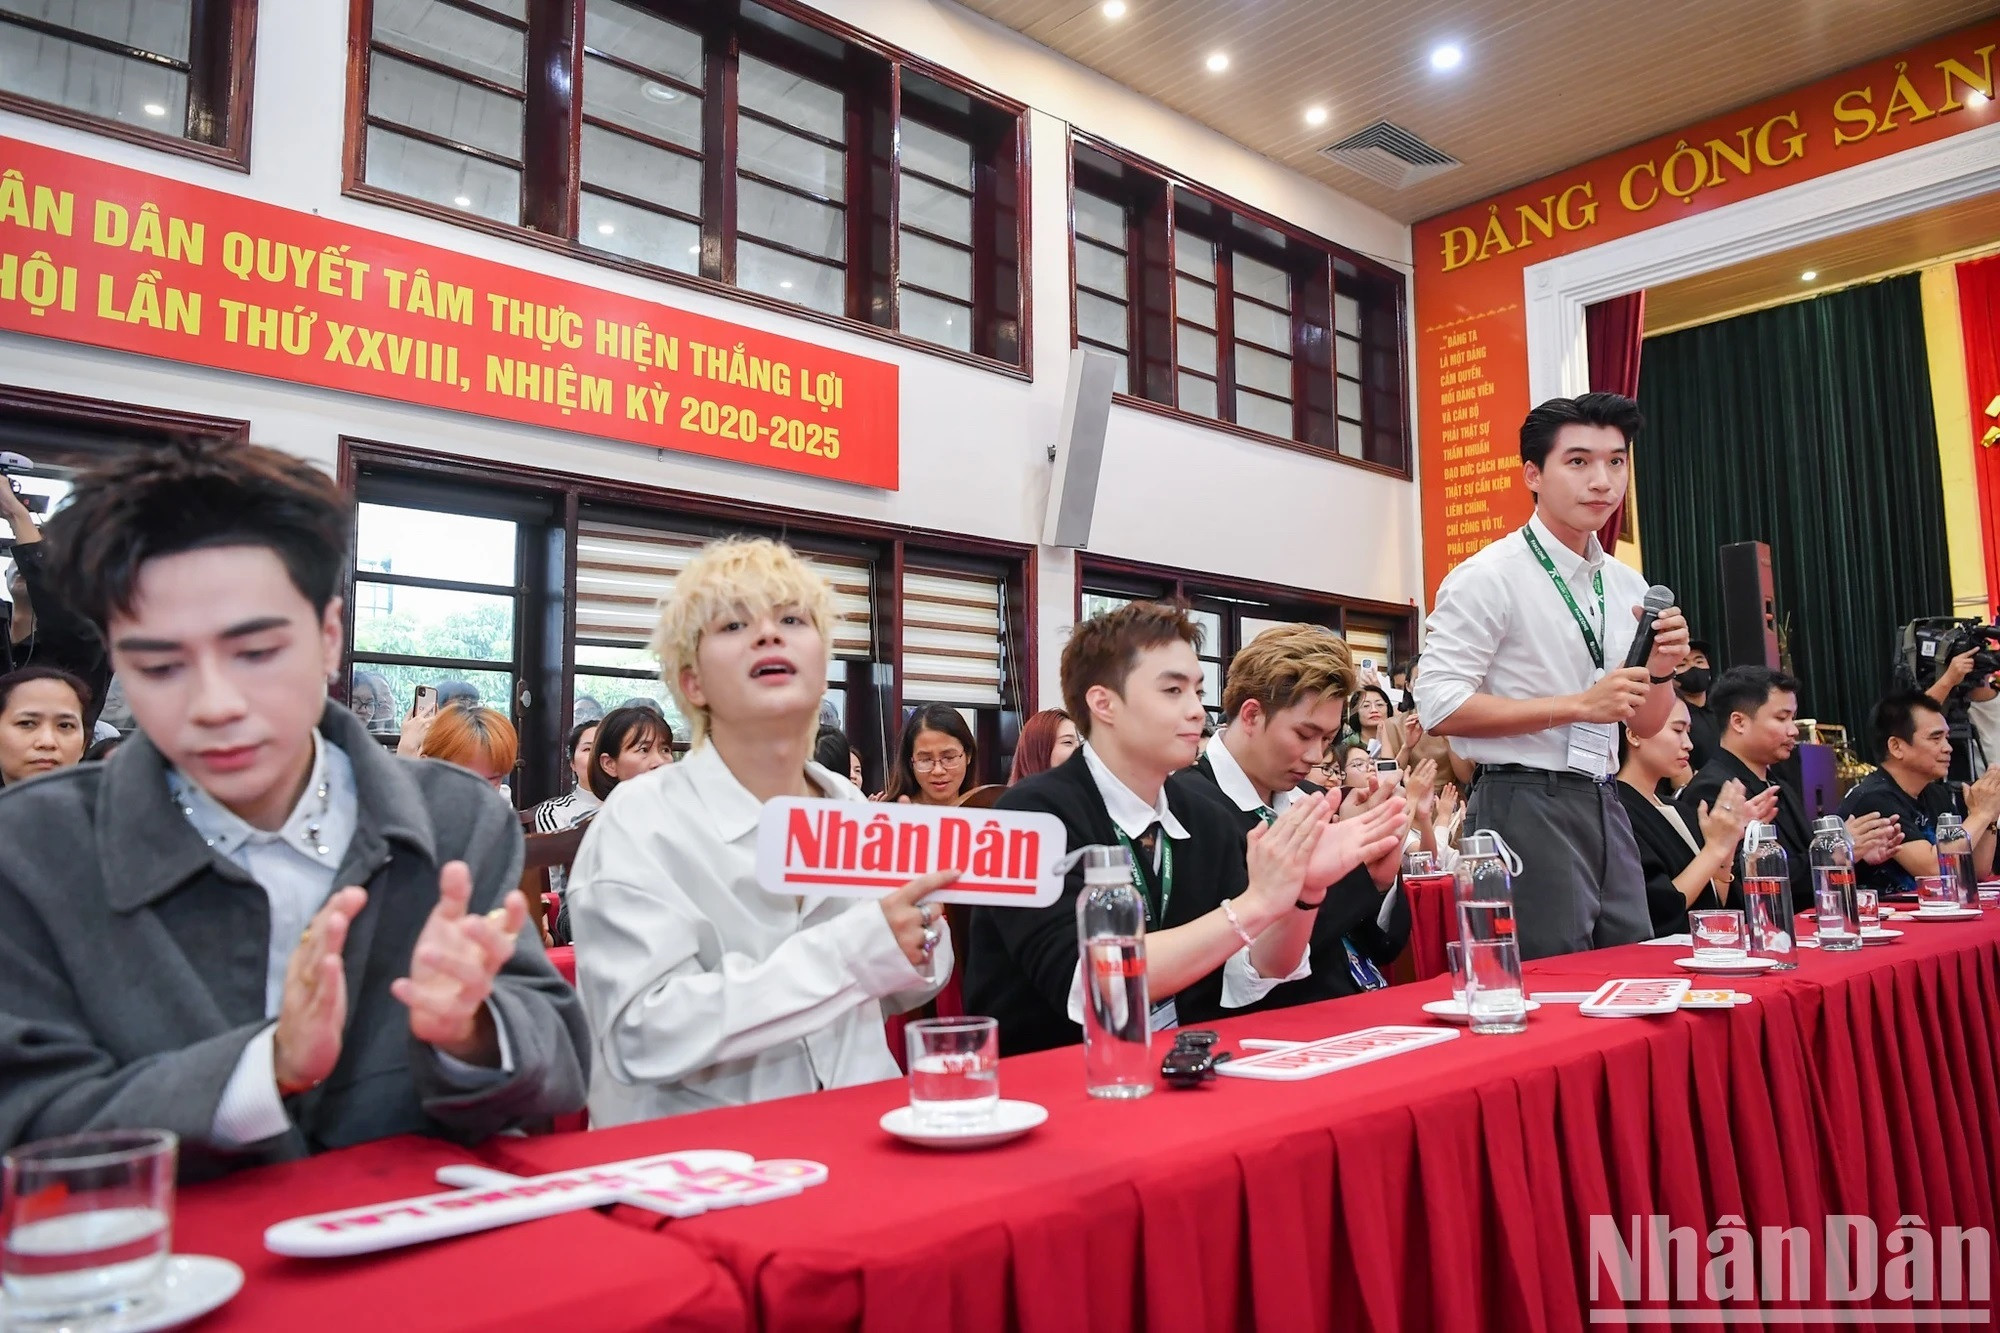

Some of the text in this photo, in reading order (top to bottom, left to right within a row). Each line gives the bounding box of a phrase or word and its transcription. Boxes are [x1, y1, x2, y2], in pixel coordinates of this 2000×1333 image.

[1440, 44, 1997, 273] ĐẢNG CỘNG SẢN
[93, 201, 205, 266] DÂN
[222, 231, 370, 301] QUYẾT
[383, 268, 474, 326] TÂM
[486, 293, 583, 351] THỰC
[595, 319, 679, 373] HIỆN
[689, 340, 791, 397] THẮNG
[801, 368, 843, 414] LỢI
[97, 268, 202, 336] LẦN
[218, 298, 319, 355] THỨ
[323, 320, 471, 393] XXVIII,
[486, 355, 613, 415] NHIỆM
[626, 381, 670, 426] KỲ
[680, 396, 841, 460] 2020-2025
[785, 807, 1040, 880] Nhân Dân
